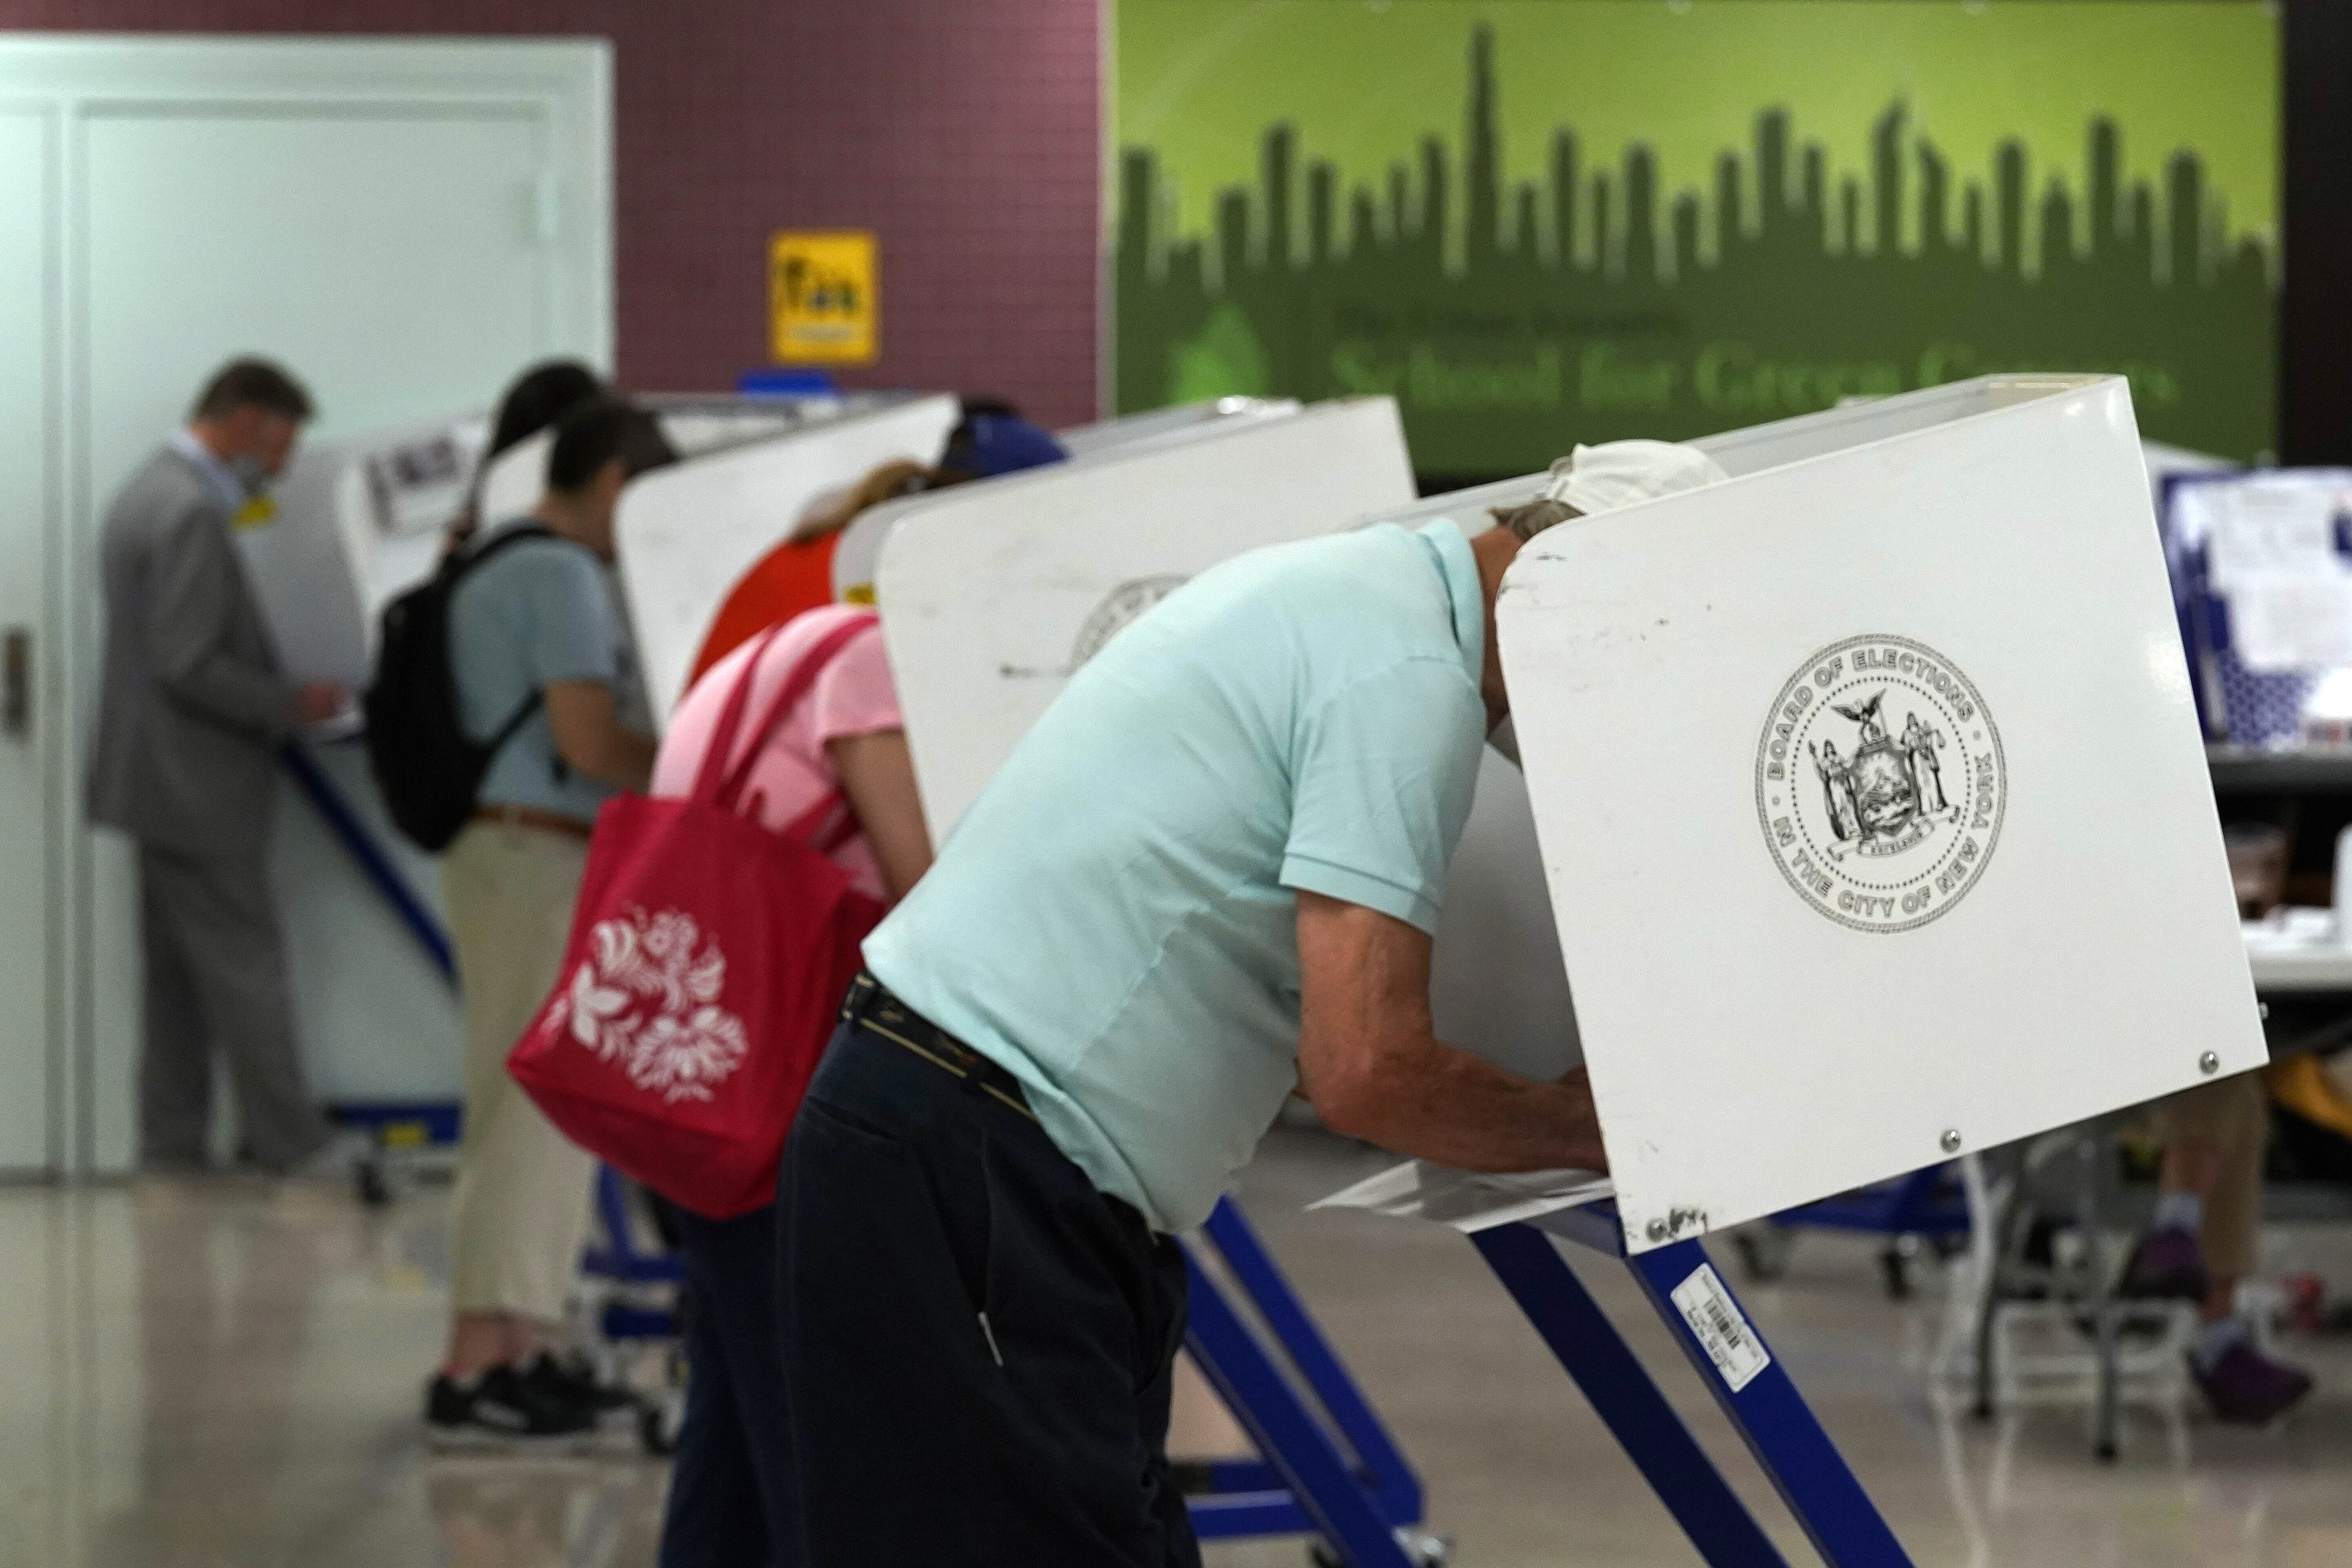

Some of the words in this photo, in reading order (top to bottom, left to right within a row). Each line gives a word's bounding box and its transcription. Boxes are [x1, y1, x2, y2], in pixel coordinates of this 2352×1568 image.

[1330, 341, 1560, 406] School
[1579, 340, 1677, 406] for
[1695, 341, 1901, 406] Green
[1767, 685, 1813, 781] BOARD
[1813, 657, 1844, 687] OF
[1851, 648, 1975, 723] ELECTIONS
[1773, 817, 1797, 848] IN
[1791, 848, 1834, 897] THE
[1837, 890, 1895, 918] CITY
[1902, 886, 1931, 913] OF
[1934, 835, 1980, 894] NEW
[1971, 752, 1995, 830] YORK
